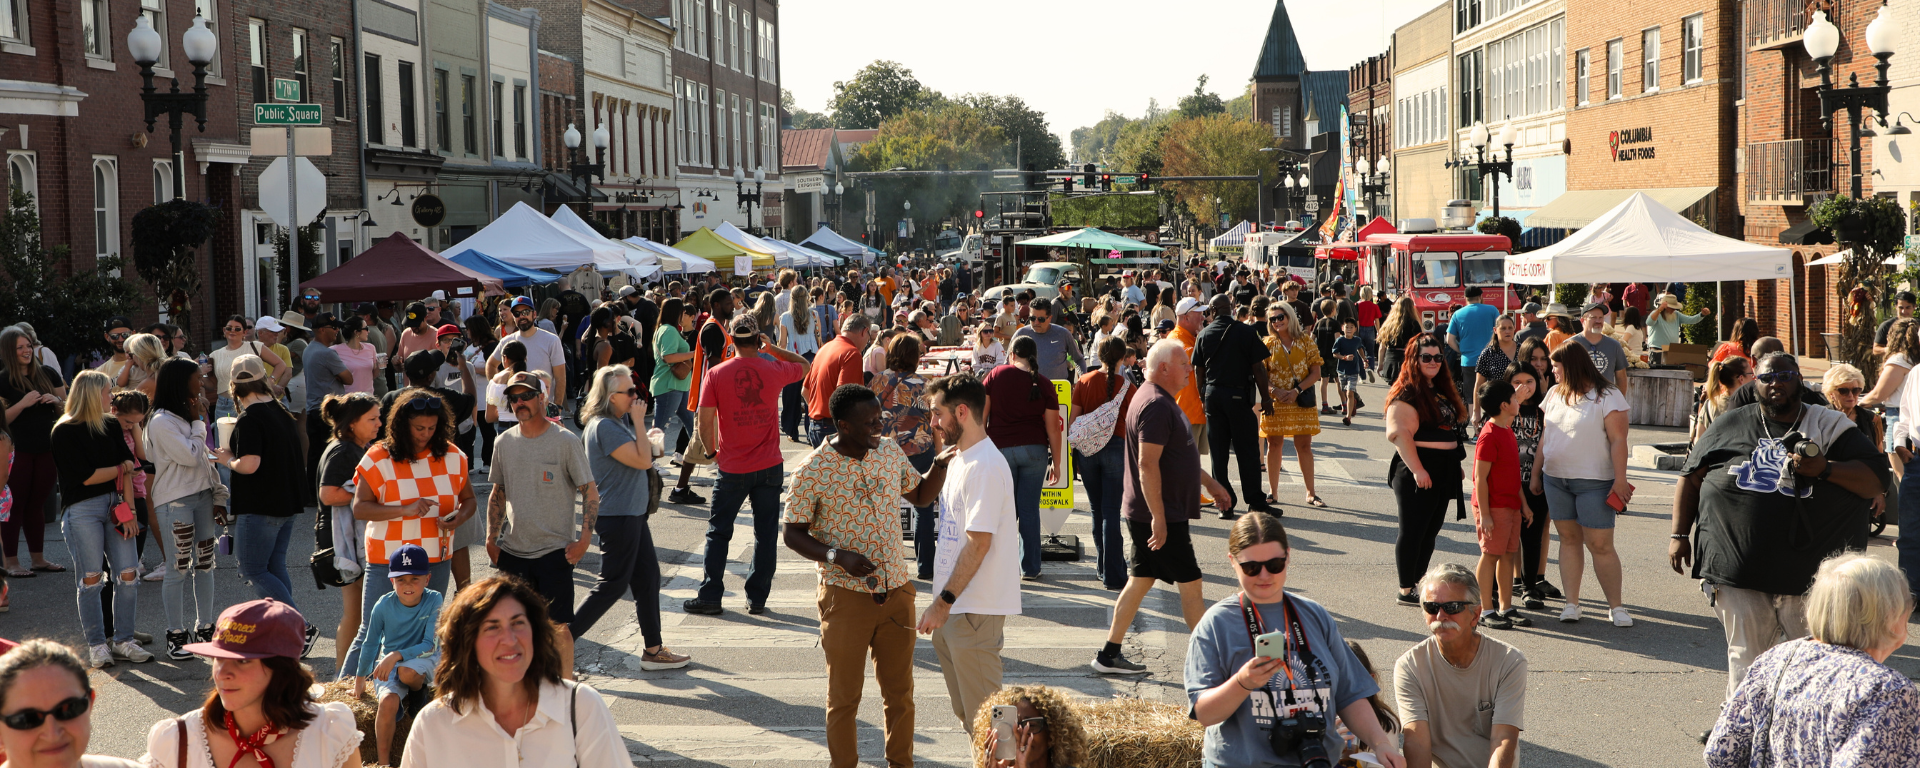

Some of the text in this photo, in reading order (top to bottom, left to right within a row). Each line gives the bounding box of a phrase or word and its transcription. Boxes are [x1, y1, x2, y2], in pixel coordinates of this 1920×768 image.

[283, 82, 292, 97] 7th
[257, 106, 319, 122] Public Square
[1620, 126, 1652, 144] COLUMBIA
[1618, 147, 1655, 161] HEALTH FOODS
[1508, 263, 1546, 276] KETTLE CORN
[402, 553, 412, 566] LA
[220, 630, 247, 644] Roots
[1293, 622, 1304, 645] Canon
